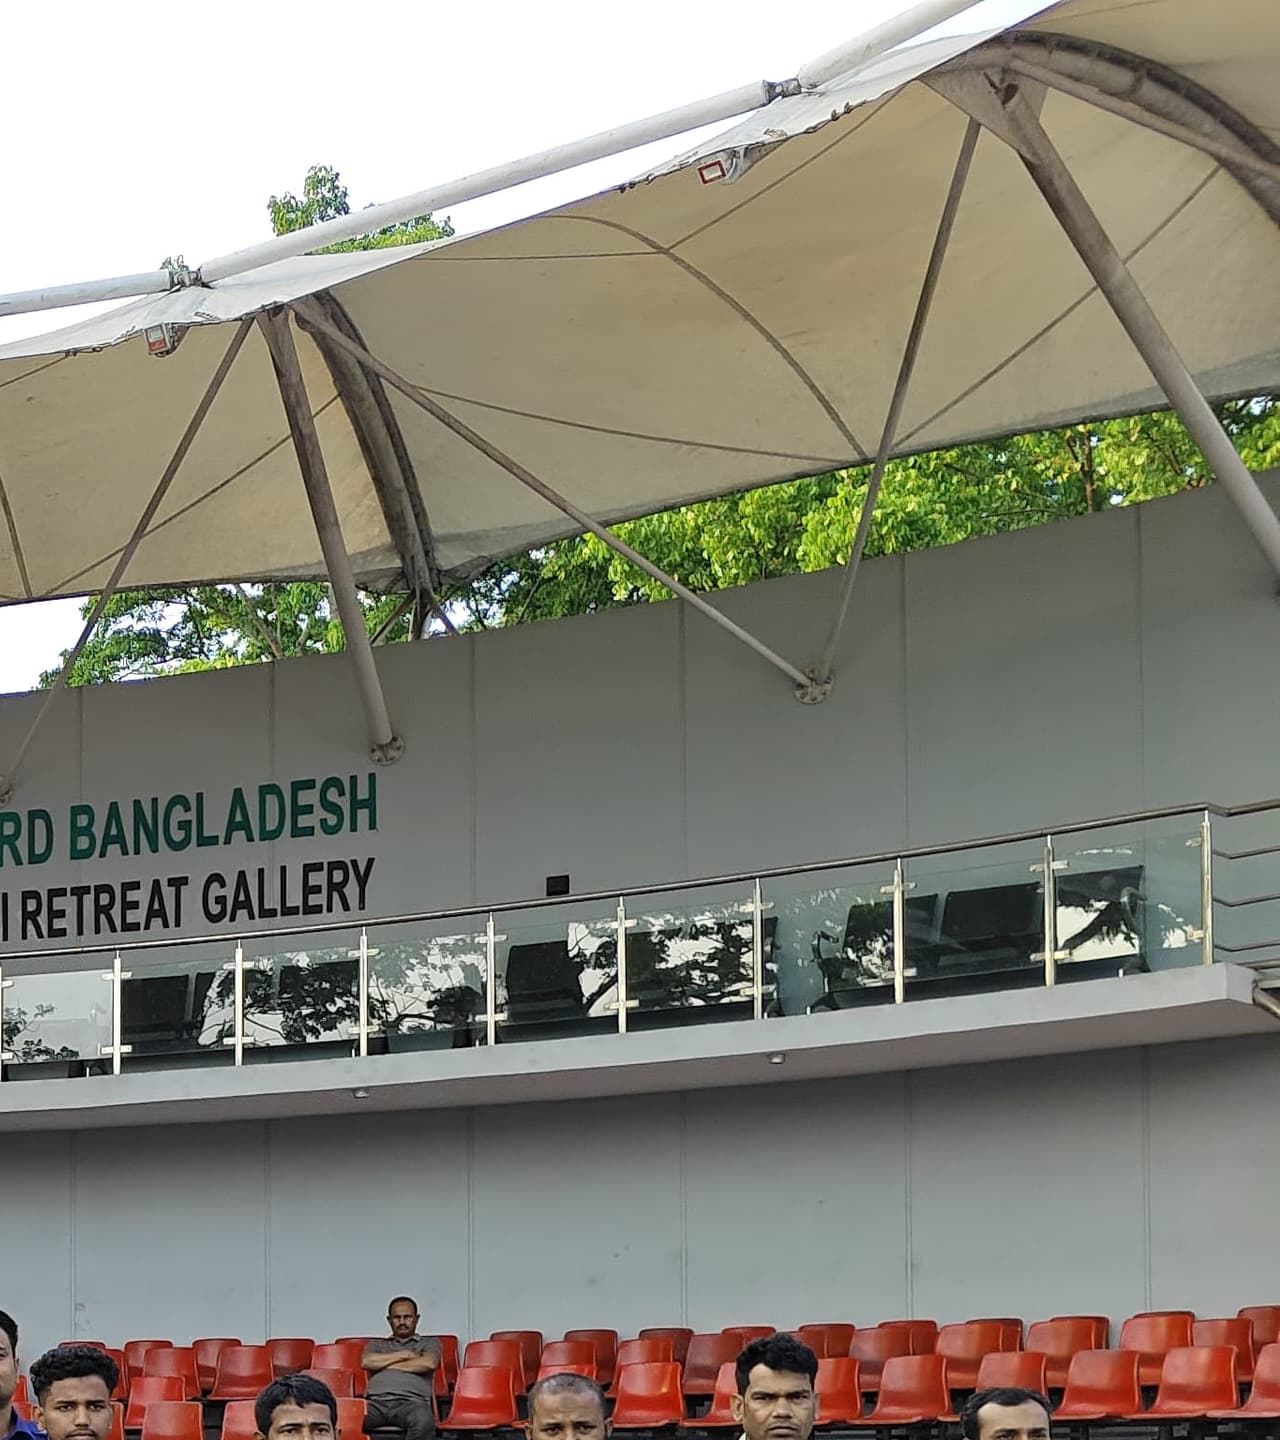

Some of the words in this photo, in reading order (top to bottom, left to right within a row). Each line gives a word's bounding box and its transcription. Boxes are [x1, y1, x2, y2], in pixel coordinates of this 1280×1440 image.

[69, 772, 378, 861] BANGLADESH
[21, 876, 189, 941] RETREAT
[201, 857, 376, 924] GALLERY
